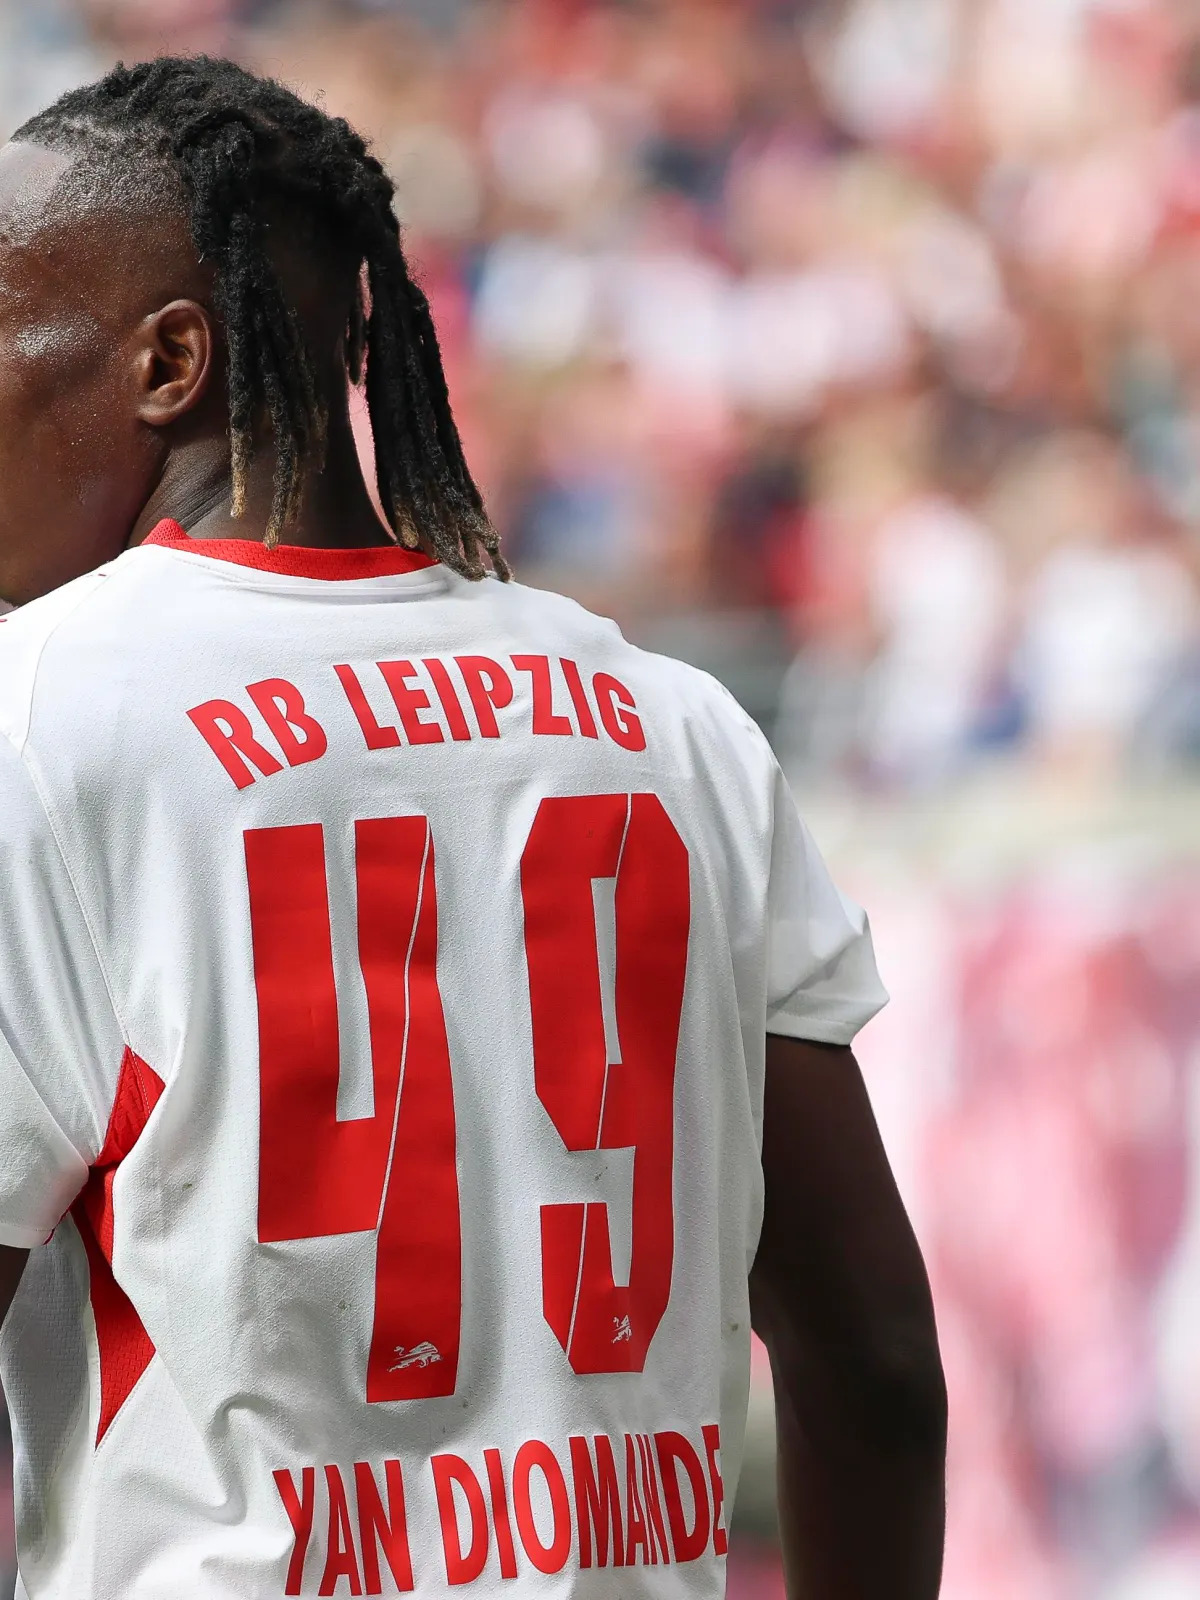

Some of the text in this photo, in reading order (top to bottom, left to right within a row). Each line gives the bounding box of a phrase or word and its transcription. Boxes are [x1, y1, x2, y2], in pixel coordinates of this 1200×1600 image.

[186, 654, 647, 790] RB LEIPZIG
[243, 792, 691, 1404] 49
[272, 1424, 728, 1597] YAN DIOMANDE
